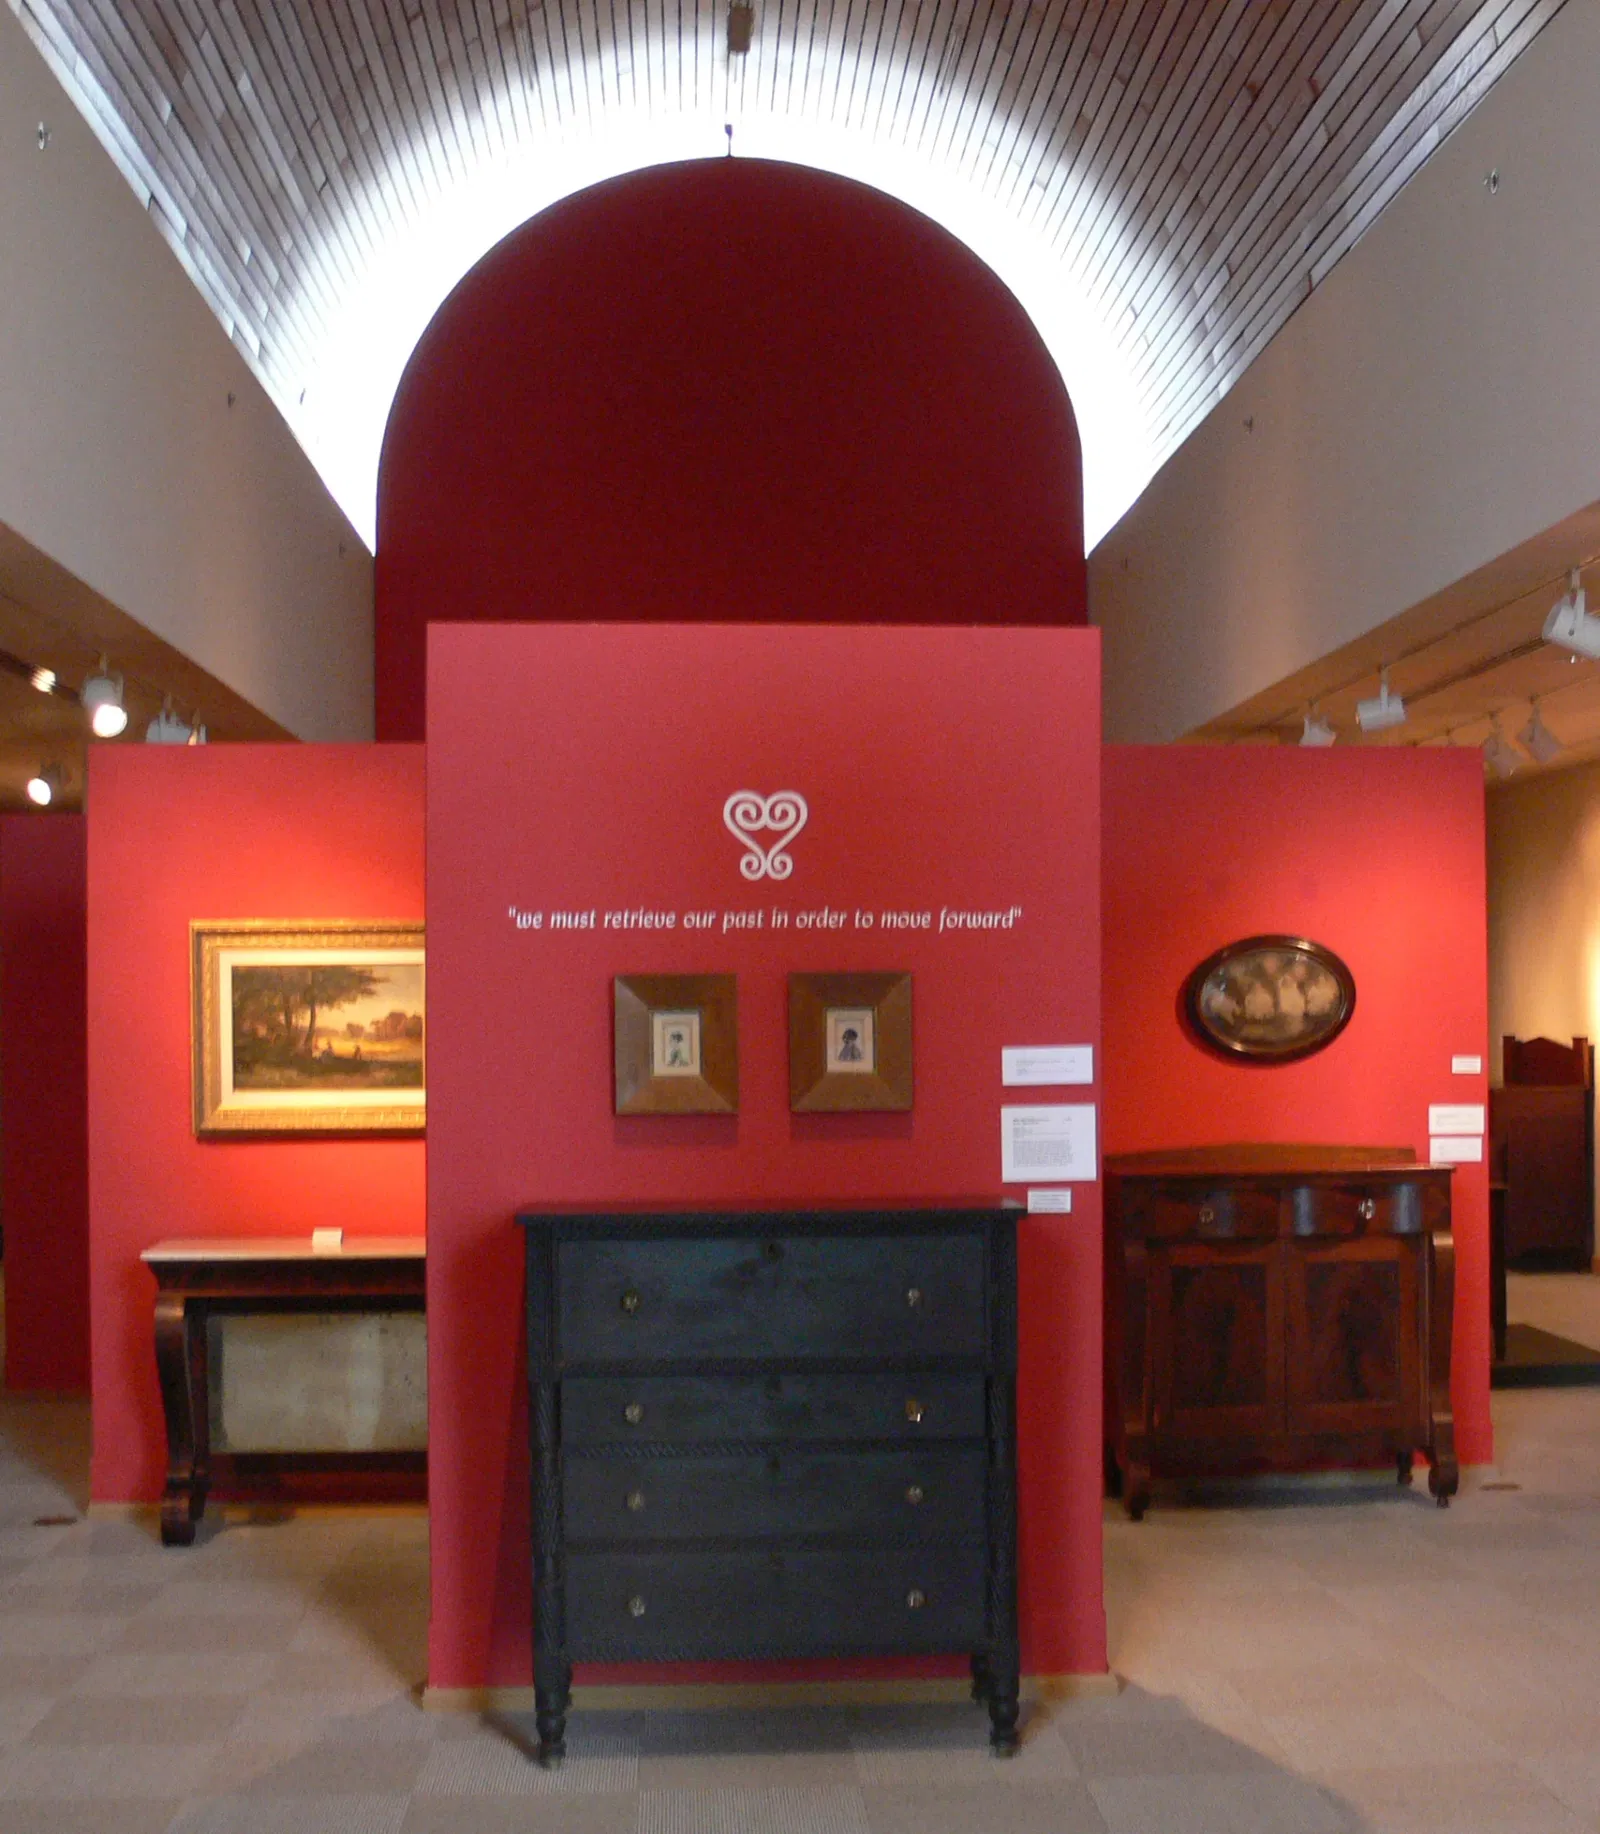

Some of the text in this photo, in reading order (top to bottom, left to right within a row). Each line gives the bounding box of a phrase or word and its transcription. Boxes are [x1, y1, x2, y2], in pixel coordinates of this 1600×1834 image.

[508, 906, 1022, 935] "we must retrieve our past in order to move forward"
